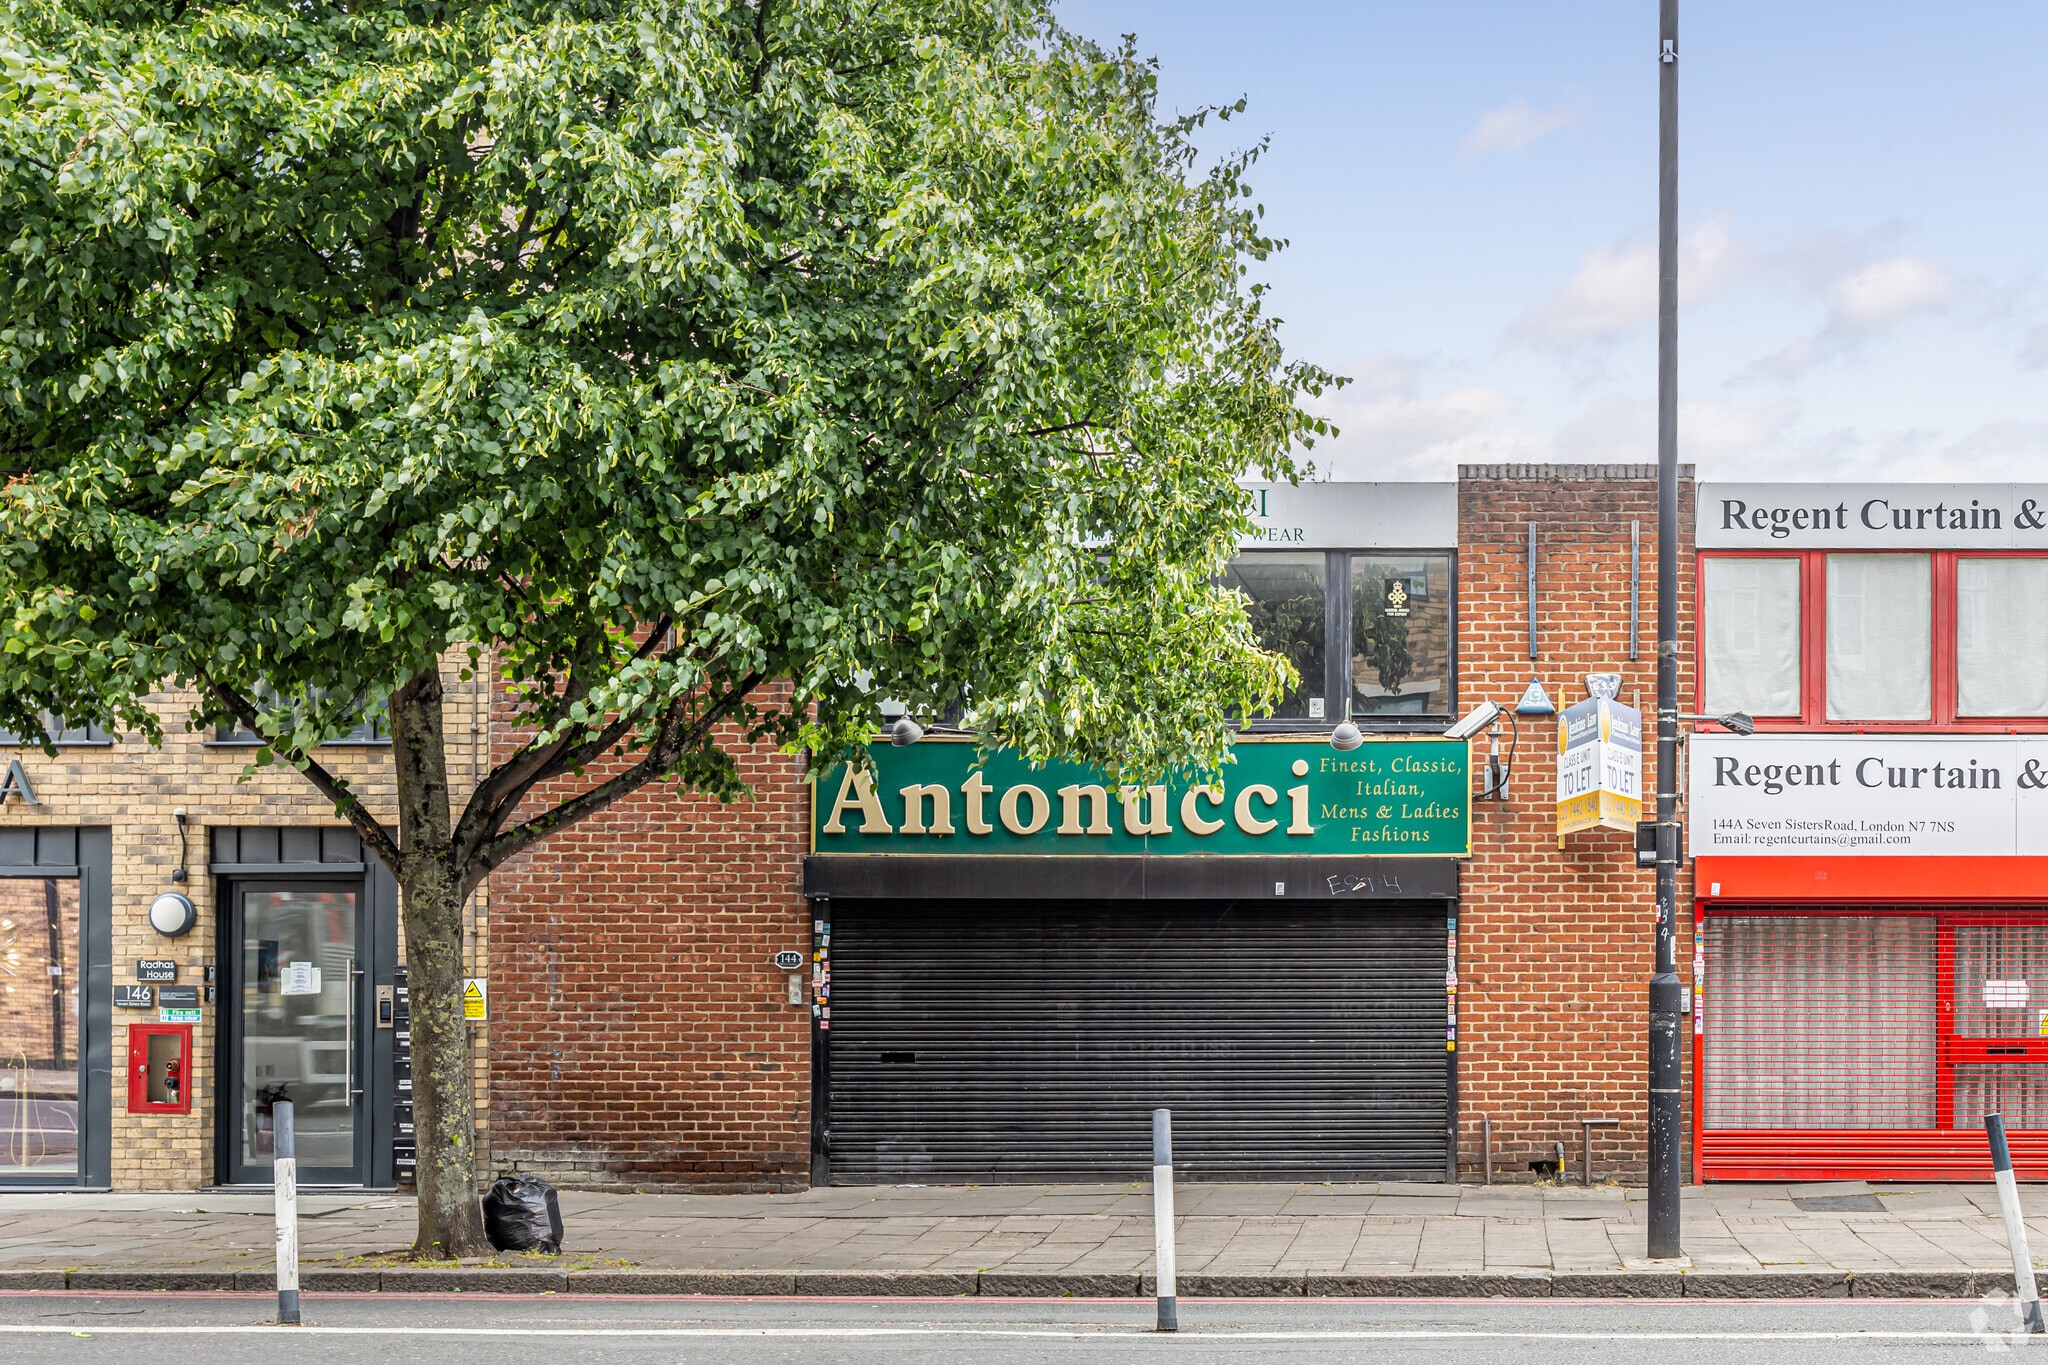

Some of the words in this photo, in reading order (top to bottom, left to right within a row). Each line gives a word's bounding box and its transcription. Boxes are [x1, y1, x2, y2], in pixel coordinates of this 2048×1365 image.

[1719, 499, 1848, 538] Regent
[1860, 499, 2002, 530] Curtain
[2013, 499, 2046, 530] &
[1319, 757, 1383, 775] Finest,
[1391, 755, 1462, 775] Classic,
[1563, 772, 1574, 796] TO
[1576, 765, 1592, 793] LET
[1607, 764, 1618, 790] TO
[1620, 769, 1635, 795] LET
[1712, 756, 1841, 796] Regent
[1855, 757, 2002, 789] Curtain
[2016, 758, 2048, 790] &
[1356, 778, 1426, 798] Italian,
[822, 759, 1315, 836] Antonucci
[1320, 803, 1368, 819] Mens
[1376, 804, 1393, 819] &
[1401, 802, 1460, 819] Ladies
[1351, 824, 1430, 842] Fashions
[1712, 818, 1743, 830] 144A
[1746, 818, 1782, 830] Seven
[1860, 820, 1905, 832] London
[1908, 821, 1926, 832] N7
[1930, 821, 1955, 832] 7NS
[1712, 833, 1752, 844] Email:
[1754, 833, 1911, 846] regentcurtains@gmail.com
[140, 960, 175, 969] Radhas
[781, 954, 797, 963] 144
[146, 970, 175, 979] House
[126, 986, 151, 1000] 146
